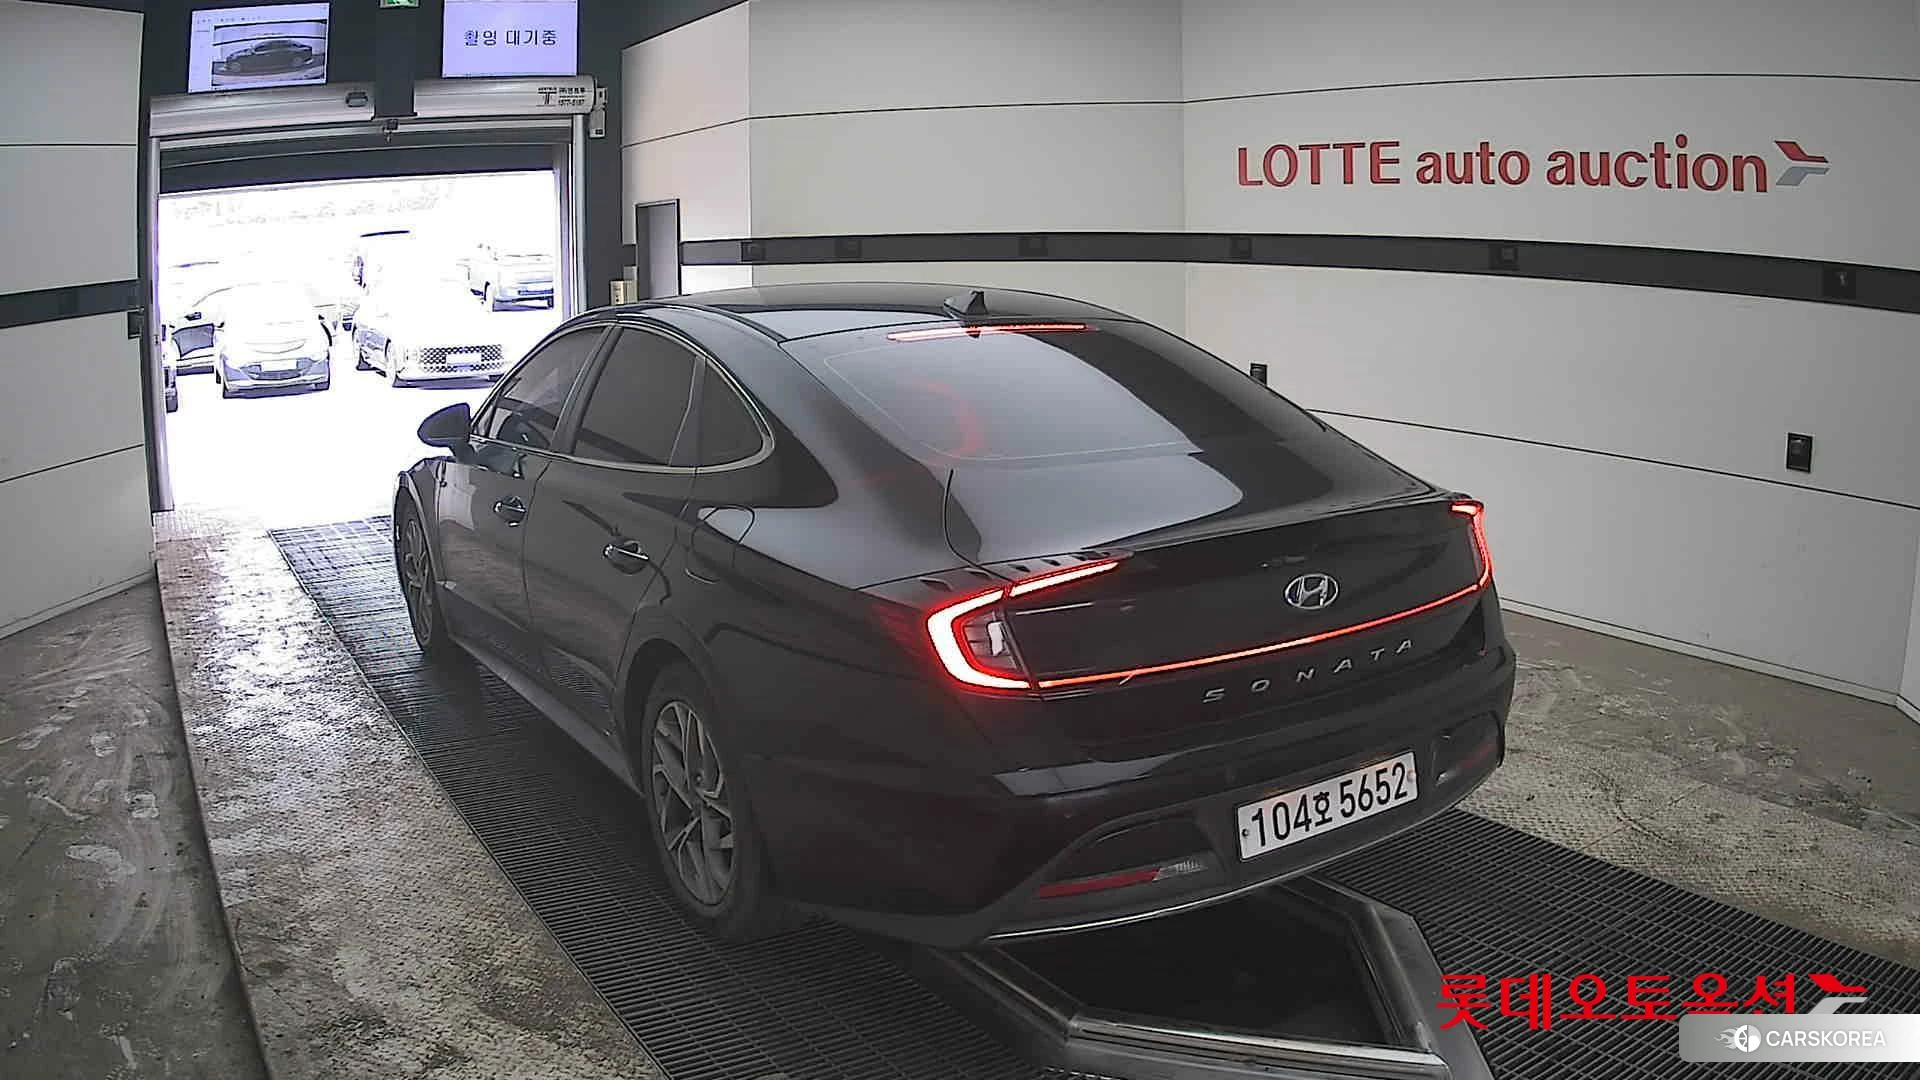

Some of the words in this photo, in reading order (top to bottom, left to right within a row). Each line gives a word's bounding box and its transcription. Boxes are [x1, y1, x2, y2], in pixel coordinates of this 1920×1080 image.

[506, 30, 556, 46] 대기중
[1238, 141, 1400, 187] LOTTE
[1416, 142, 1530, 185] auto
[1546, 134, 1767, 193] auction
[1203, 639, 1412, 703] SONATA
[1252, 791, 1333, 847] 104호
[1340, 762, 1408, 818] 5652
